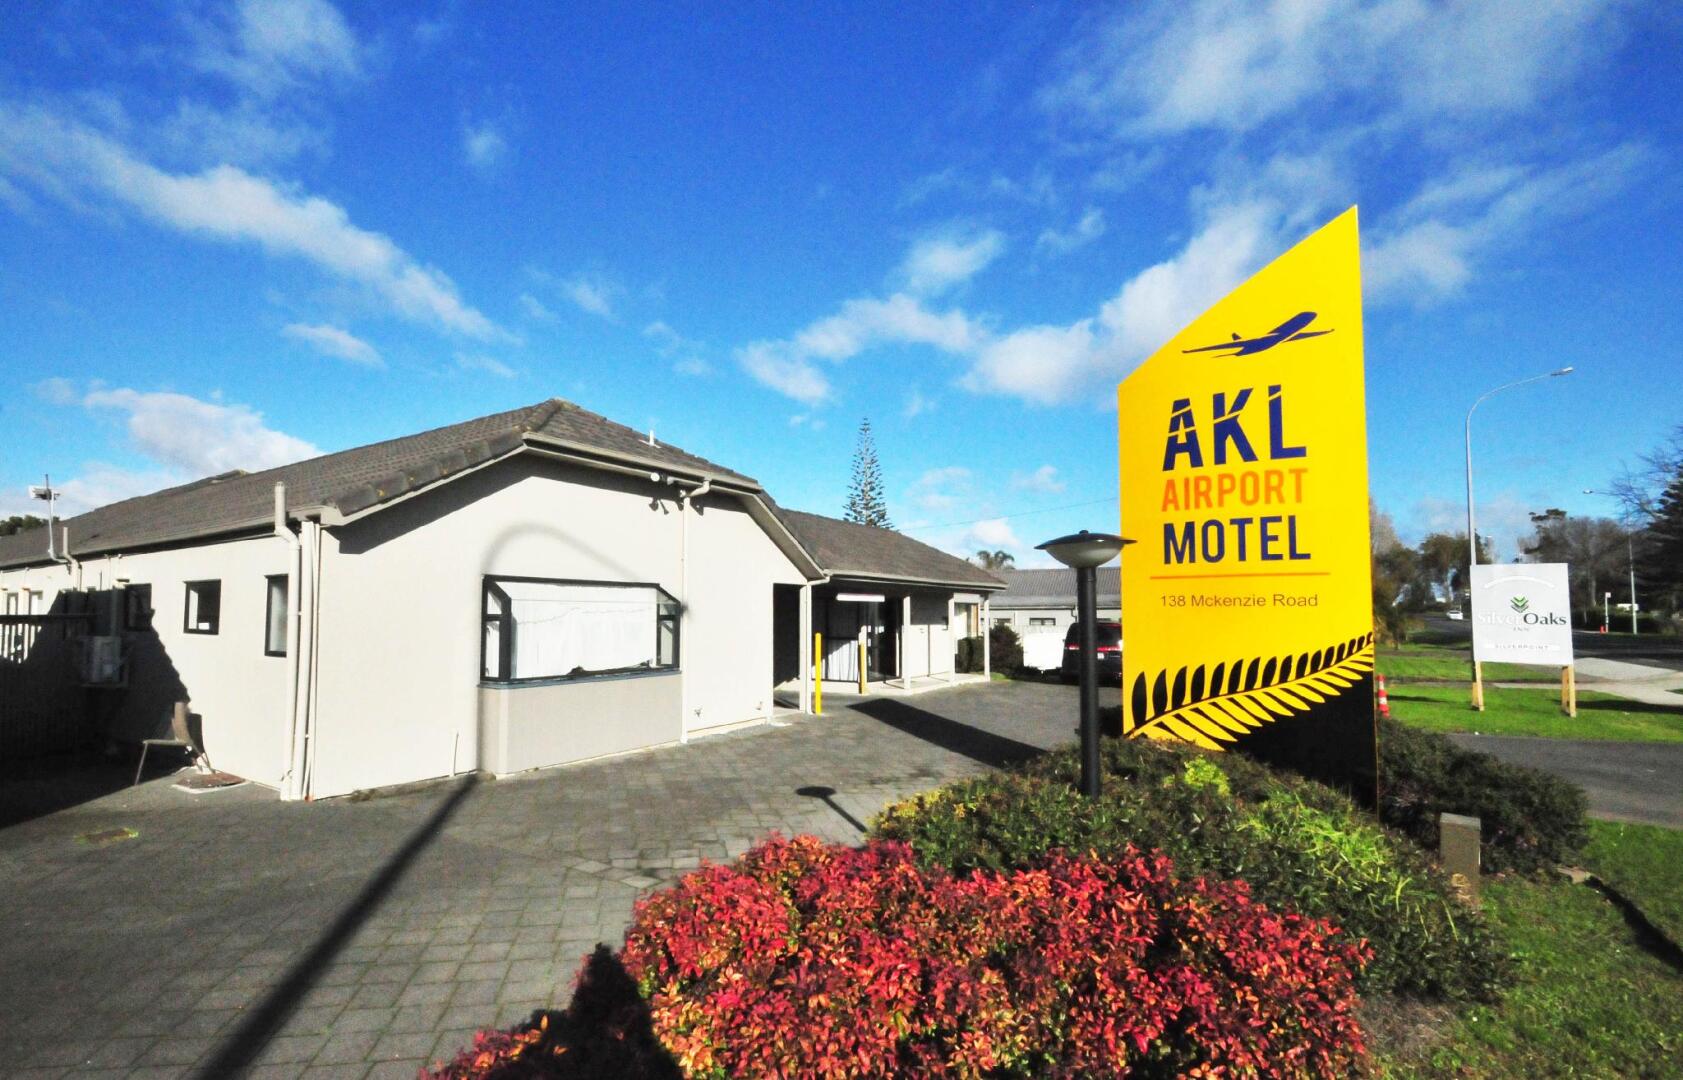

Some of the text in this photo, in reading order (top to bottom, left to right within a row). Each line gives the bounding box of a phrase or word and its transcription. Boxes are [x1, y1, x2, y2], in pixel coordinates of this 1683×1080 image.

[1162, 384, 1306, 471] AKL
[1161, 468, 1308, 512] AIRPORT
[1163, 515, 1311, 564] MOTEL
[1161, 594, 1318, 607] 138 Mckenzie Road
